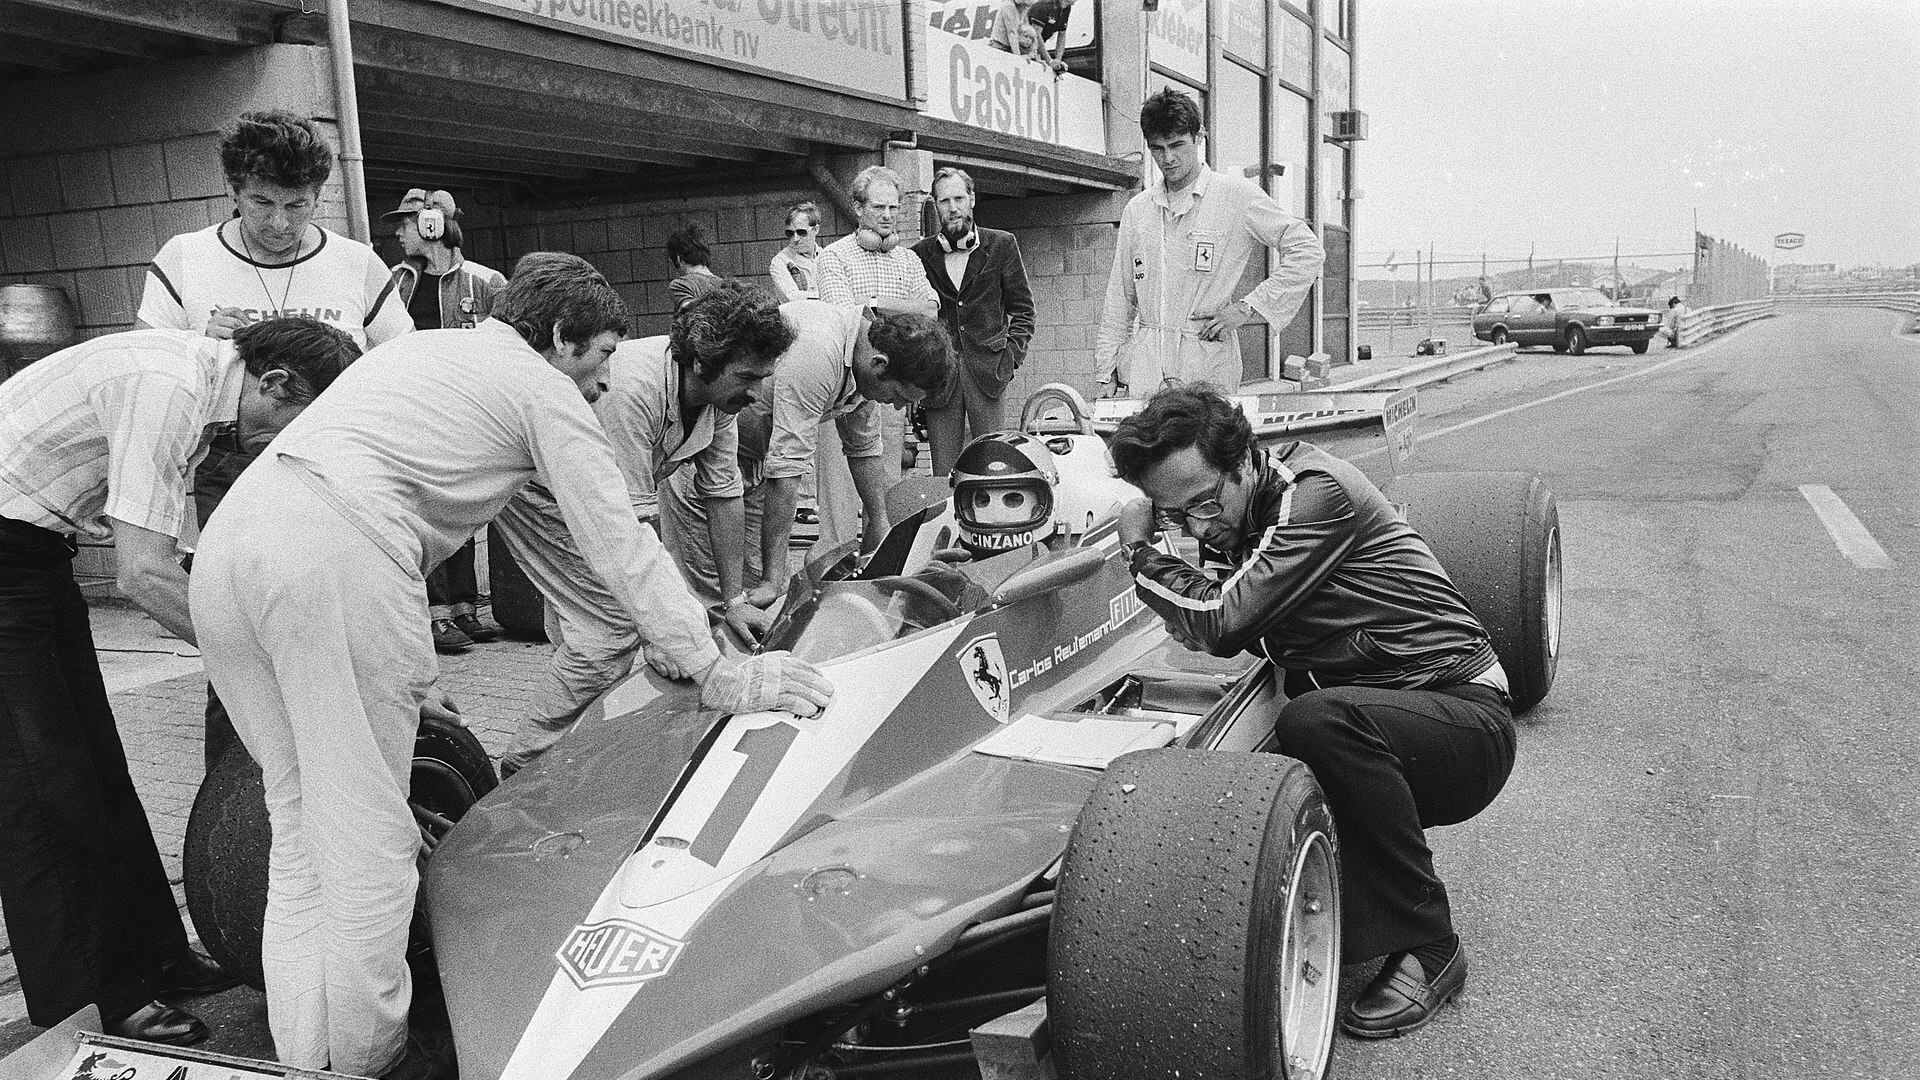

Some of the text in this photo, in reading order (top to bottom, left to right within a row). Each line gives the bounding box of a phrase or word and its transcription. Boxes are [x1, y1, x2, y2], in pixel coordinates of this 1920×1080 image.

[950, 44, 1059, 143] Castrol
[971, 531, 1033, 549] CINZANO
[1009, 619, 1113, 690] Carlos Reutemann
[689, 720, 801, 868] 1
[567, 926, 670, 978] HEUER
